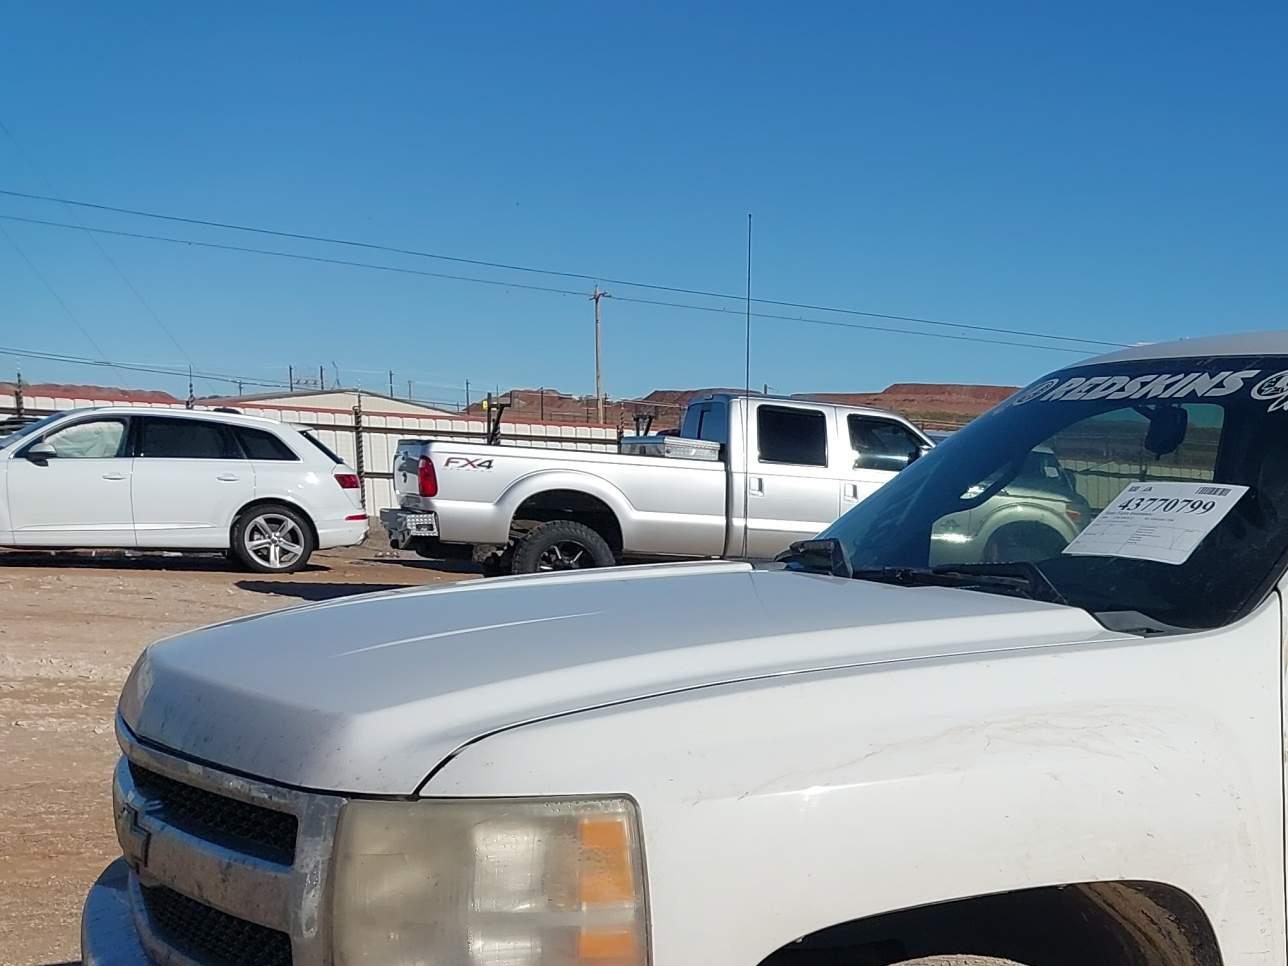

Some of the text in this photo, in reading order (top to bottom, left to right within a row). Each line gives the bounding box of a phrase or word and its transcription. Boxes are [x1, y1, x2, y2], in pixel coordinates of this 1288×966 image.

[1040, 369, 1262, 401] REDSKINS
[444, 457, 494, 469] FX4
[1117, 497, 1216, 515] 43770799
